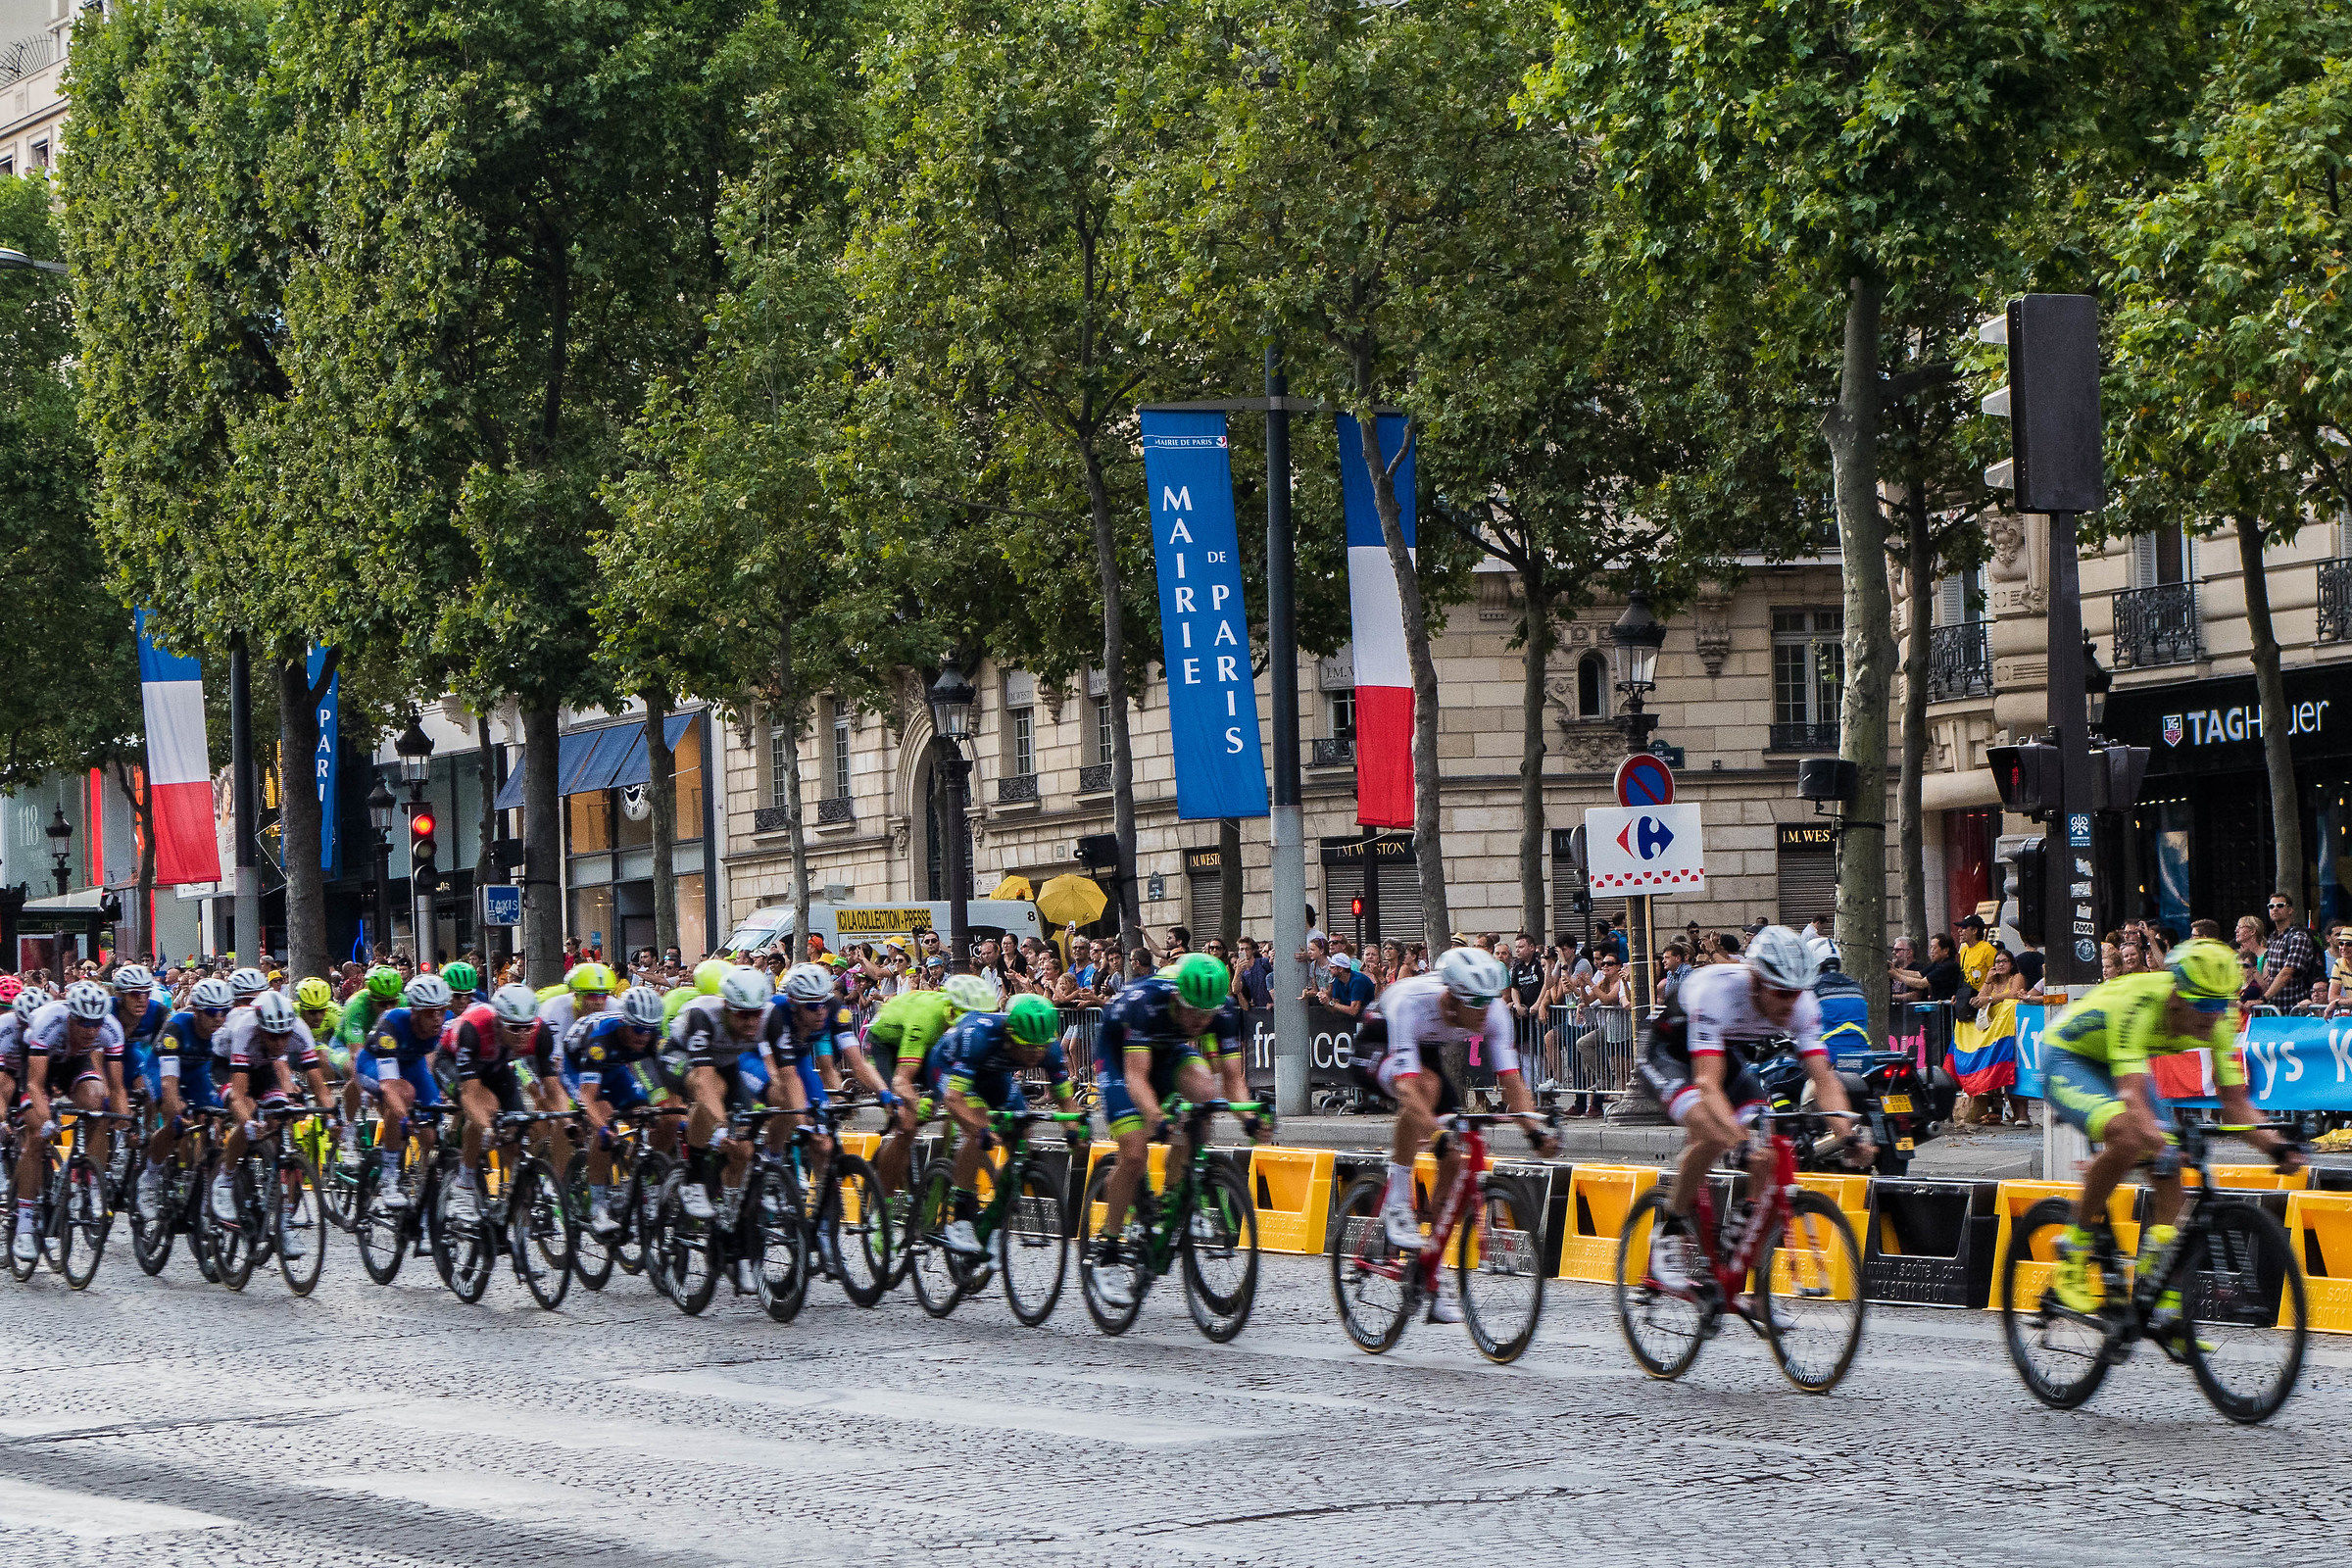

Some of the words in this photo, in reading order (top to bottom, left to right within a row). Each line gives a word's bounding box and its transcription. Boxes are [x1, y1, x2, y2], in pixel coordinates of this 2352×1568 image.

[1207, 551, 1227, 564] DE
[1163, 485, 1201, 685] MAIRIE
[1211, 584, 1245, 755] PARIS
[316, 709, 331, 802] PARI
[1355, 842, 1405, 856] WSTON
[837, 910, 848, 930] ICI
[848, 910, 858, 930] LA
[857, 909, 901, 930] COLLECTION
[904, 908, 932, 929] PRESSE
[1027, 910, 1036, 922] 8
